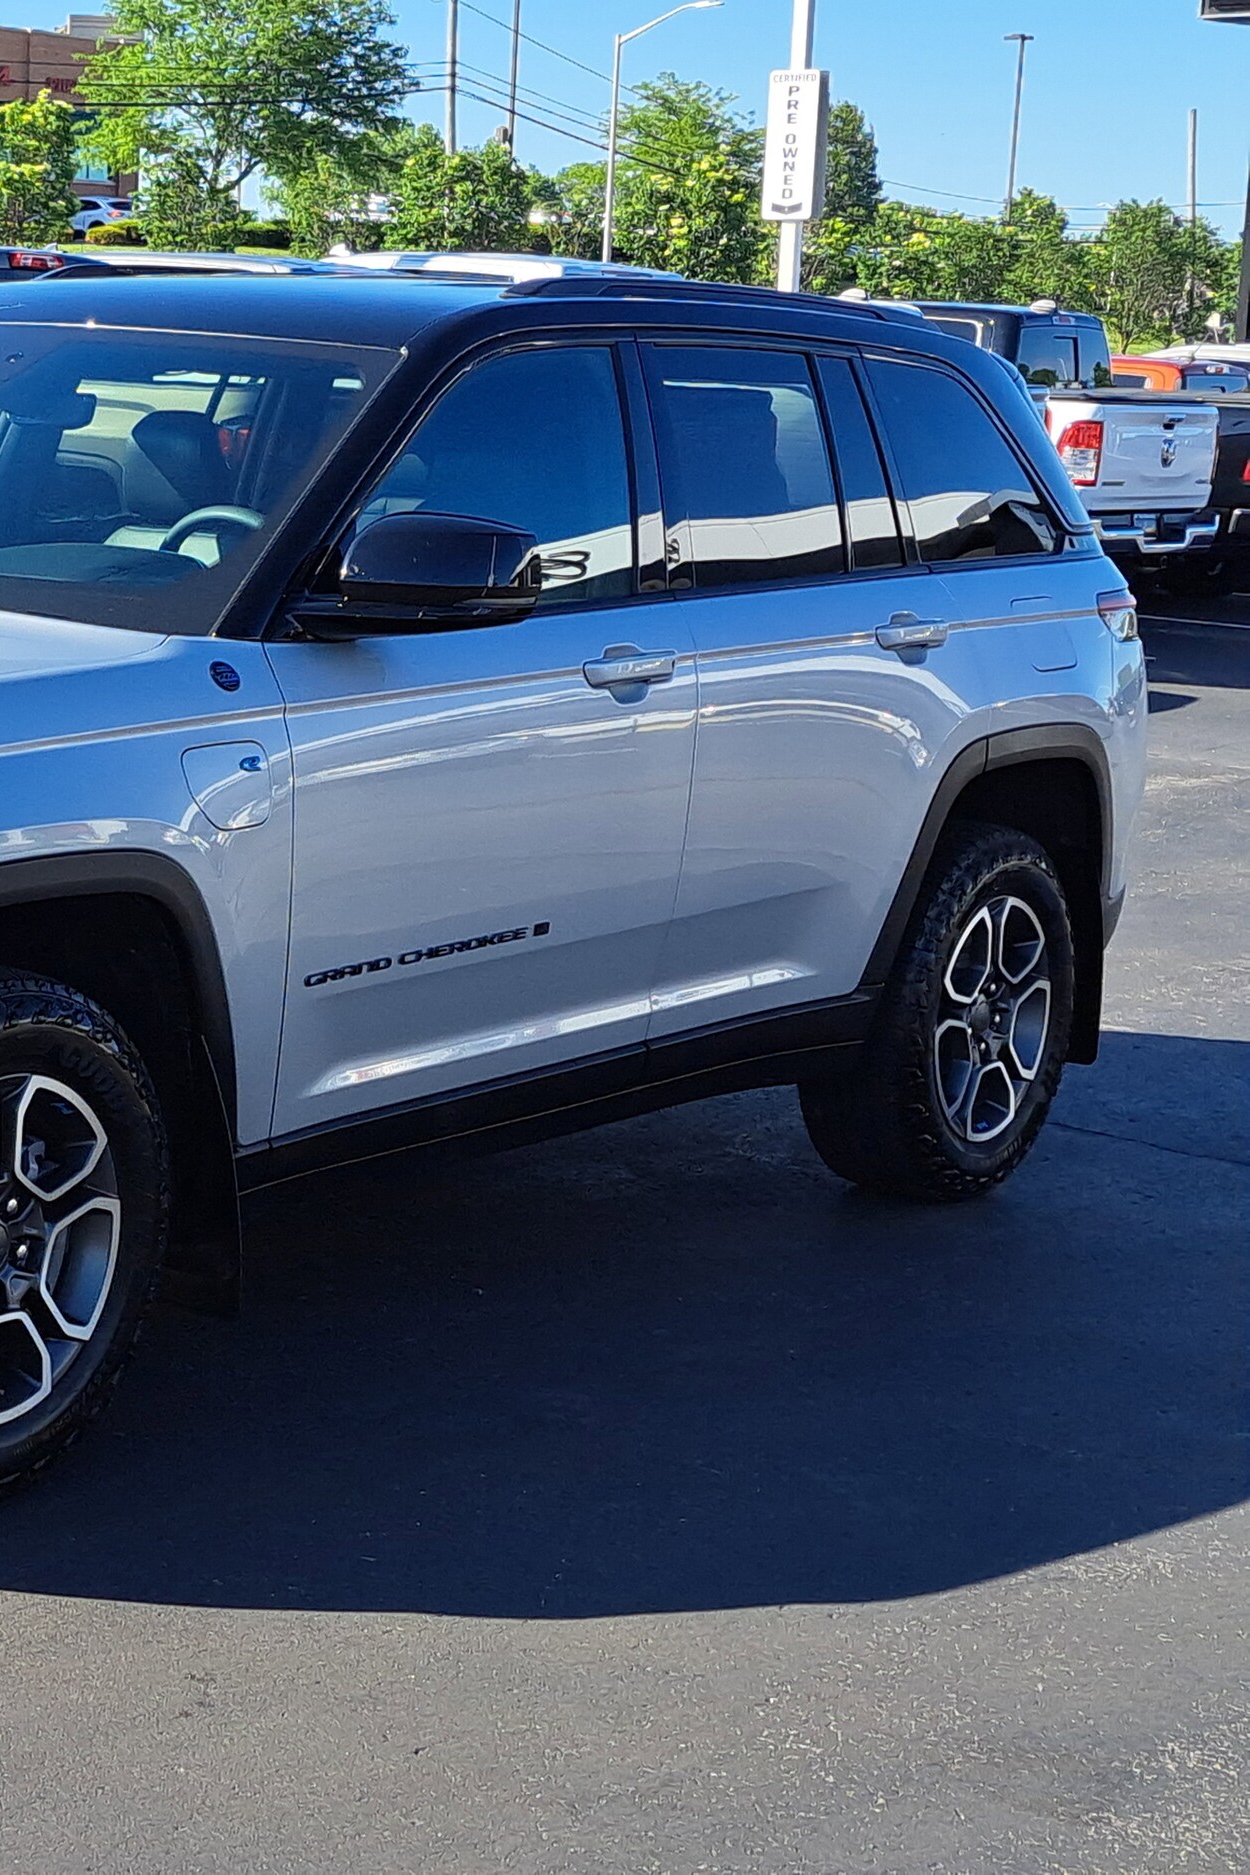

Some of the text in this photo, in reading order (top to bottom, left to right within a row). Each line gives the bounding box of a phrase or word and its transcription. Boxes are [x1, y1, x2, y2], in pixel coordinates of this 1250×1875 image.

[773, 73, 817, 83] CERTIFIED
[782, 85, 800, 199] PRE OWNED
[303, 926, 529, 988] GRAND CHEROKEE
